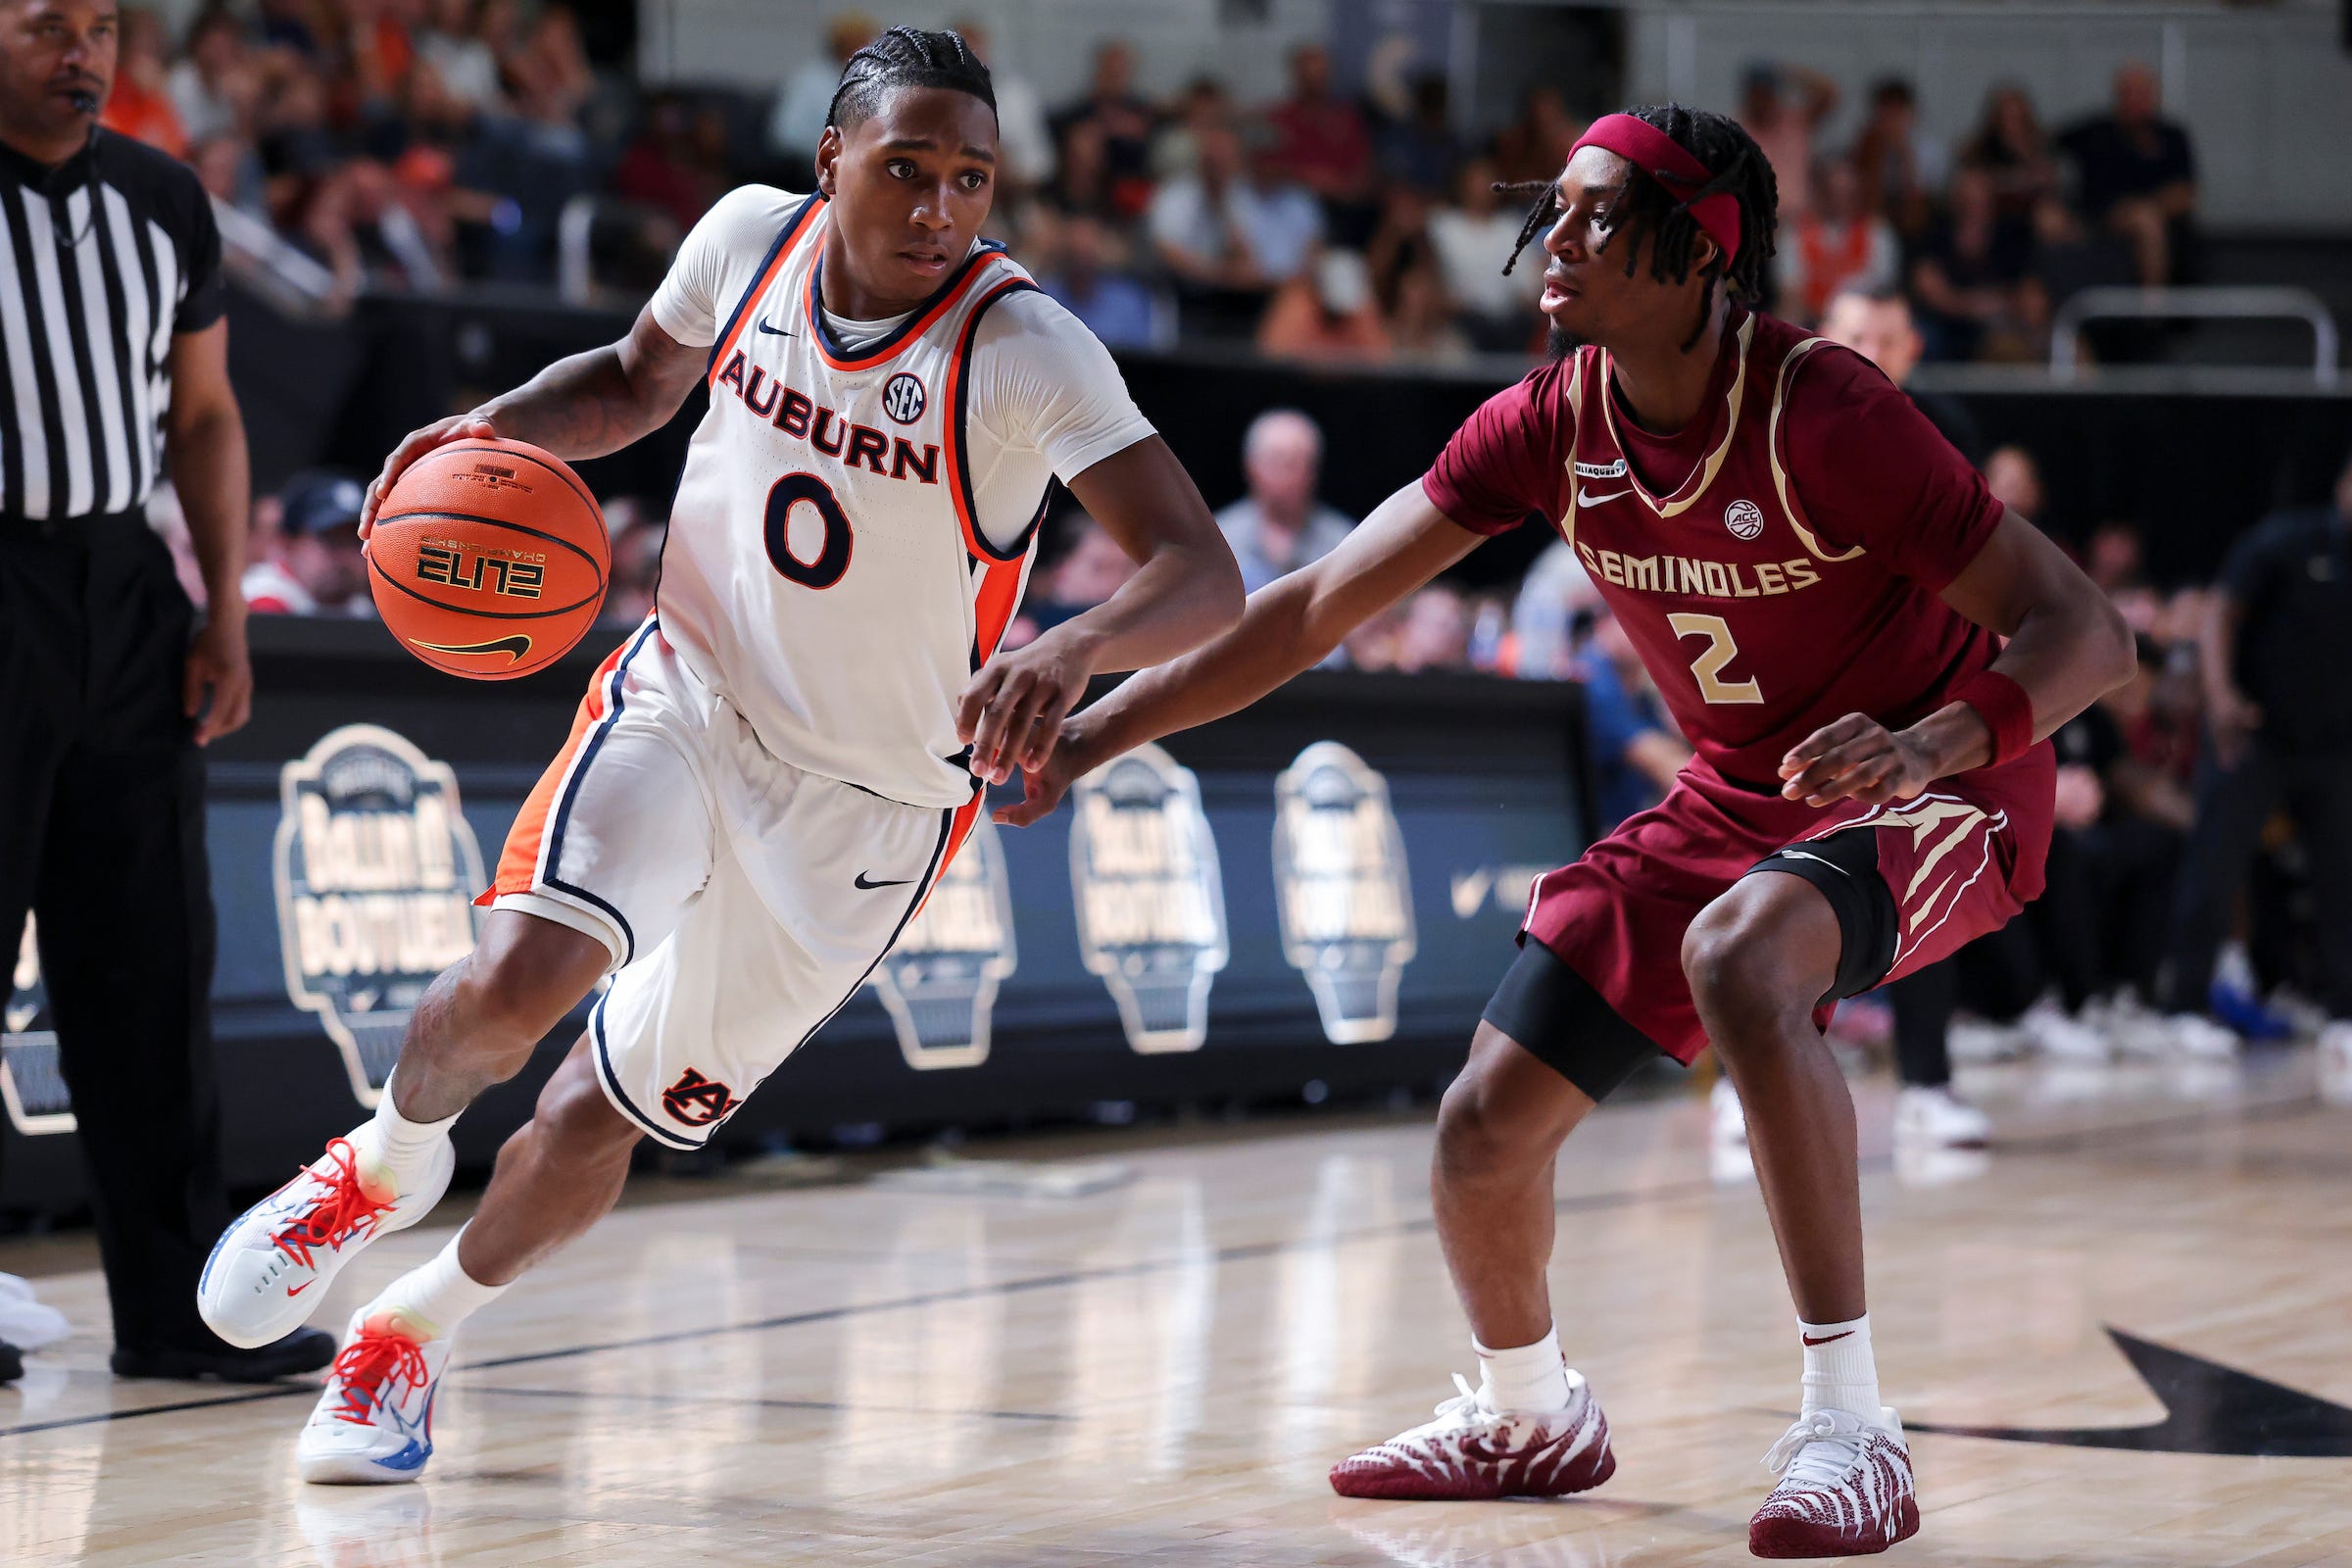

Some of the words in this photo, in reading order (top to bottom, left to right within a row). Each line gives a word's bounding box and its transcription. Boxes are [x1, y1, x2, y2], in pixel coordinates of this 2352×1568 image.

[718, 348, 940, 485] AUBURN
[885, 375, 924, 421] SEC
[763, 471, 854, 590] 0
[1732, 511, 1758, 523] ACC
[416, 546, 545, 600] ELITE
[1576, 540, 1823, 598] SEMINOLES
[1666, 612, 1764, 705] 2
